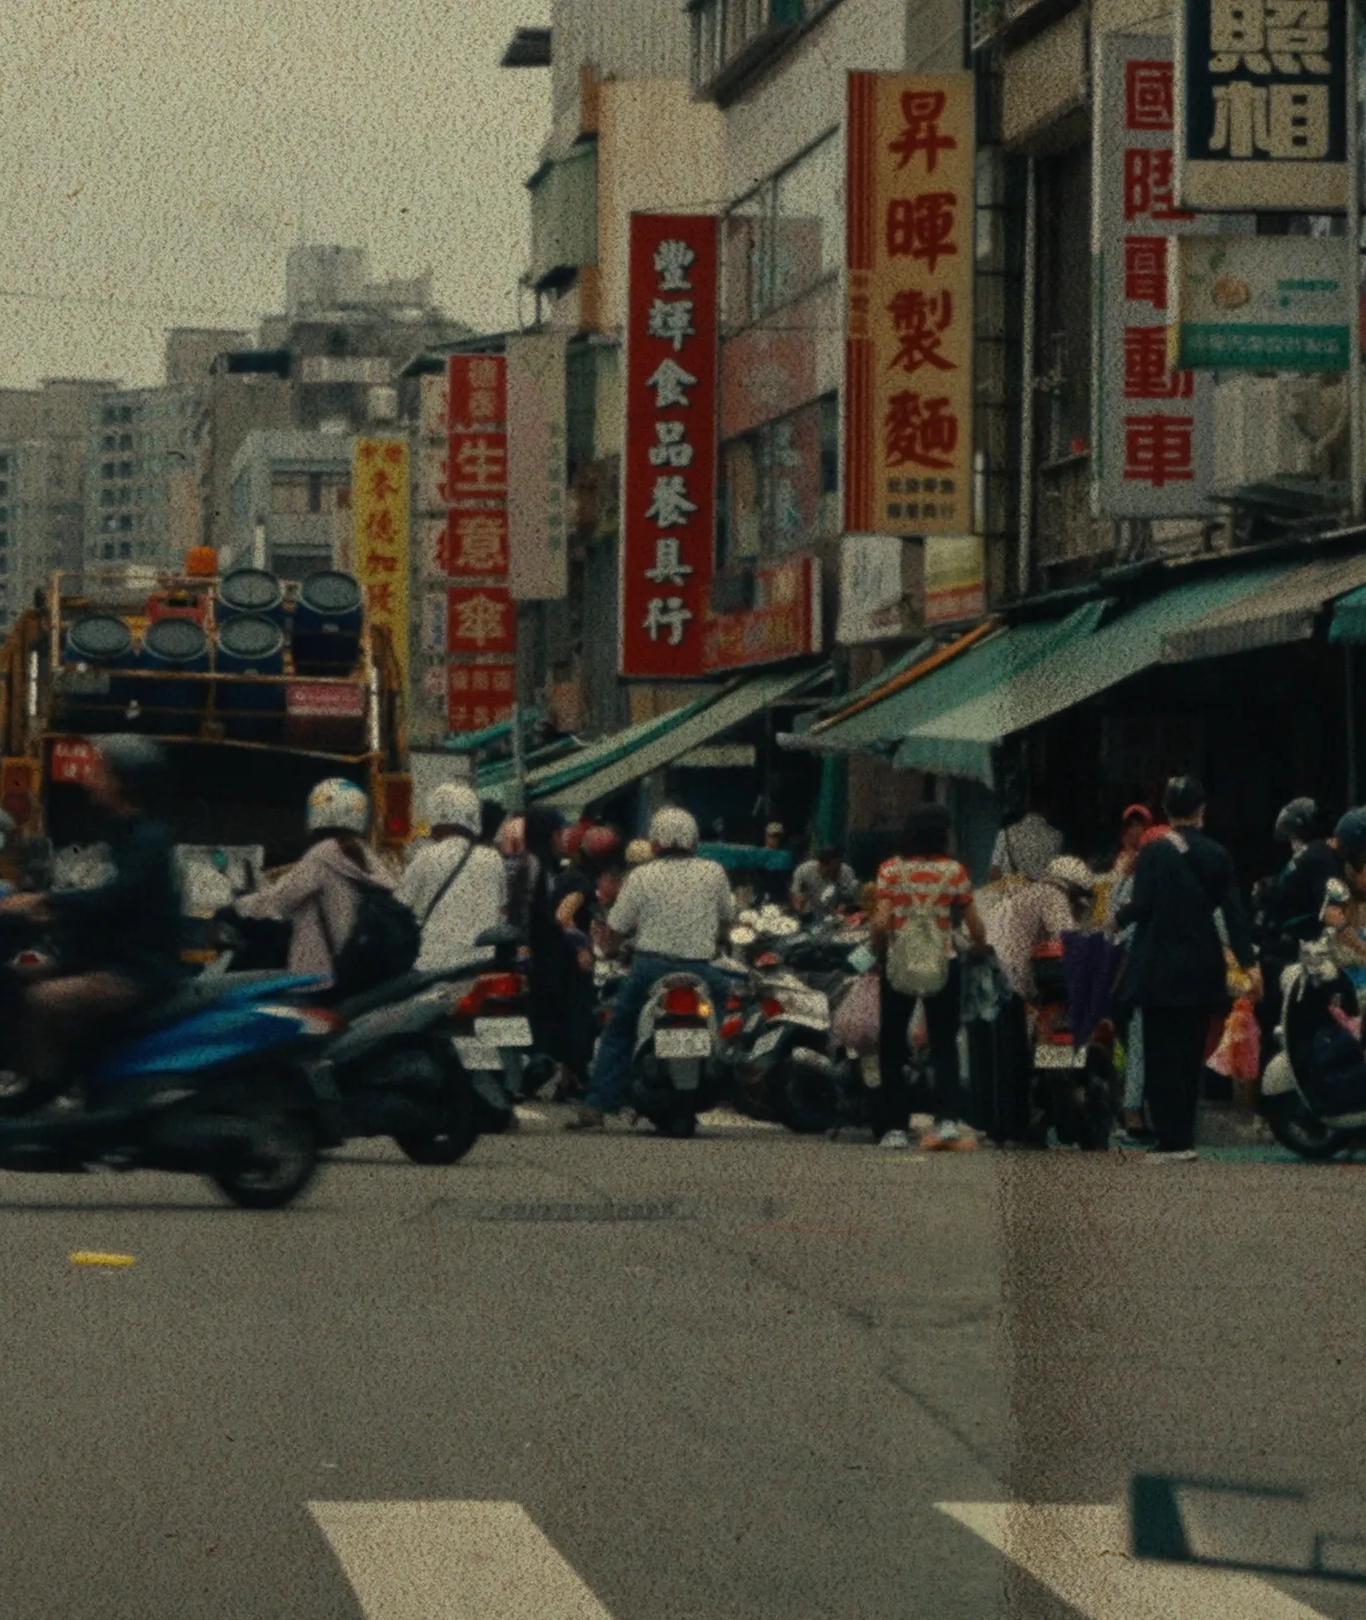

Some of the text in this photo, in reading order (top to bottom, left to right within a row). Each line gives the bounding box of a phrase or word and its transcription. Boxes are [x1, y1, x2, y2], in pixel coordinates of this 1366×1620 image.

[1208, 0, 1332, 157] 照相
[885, 90, 958, 470] 昇暉製麵
[456, 440, 507, 647] 生意傘
[643, 239, 698, 647] 豐輝食品餐具行
